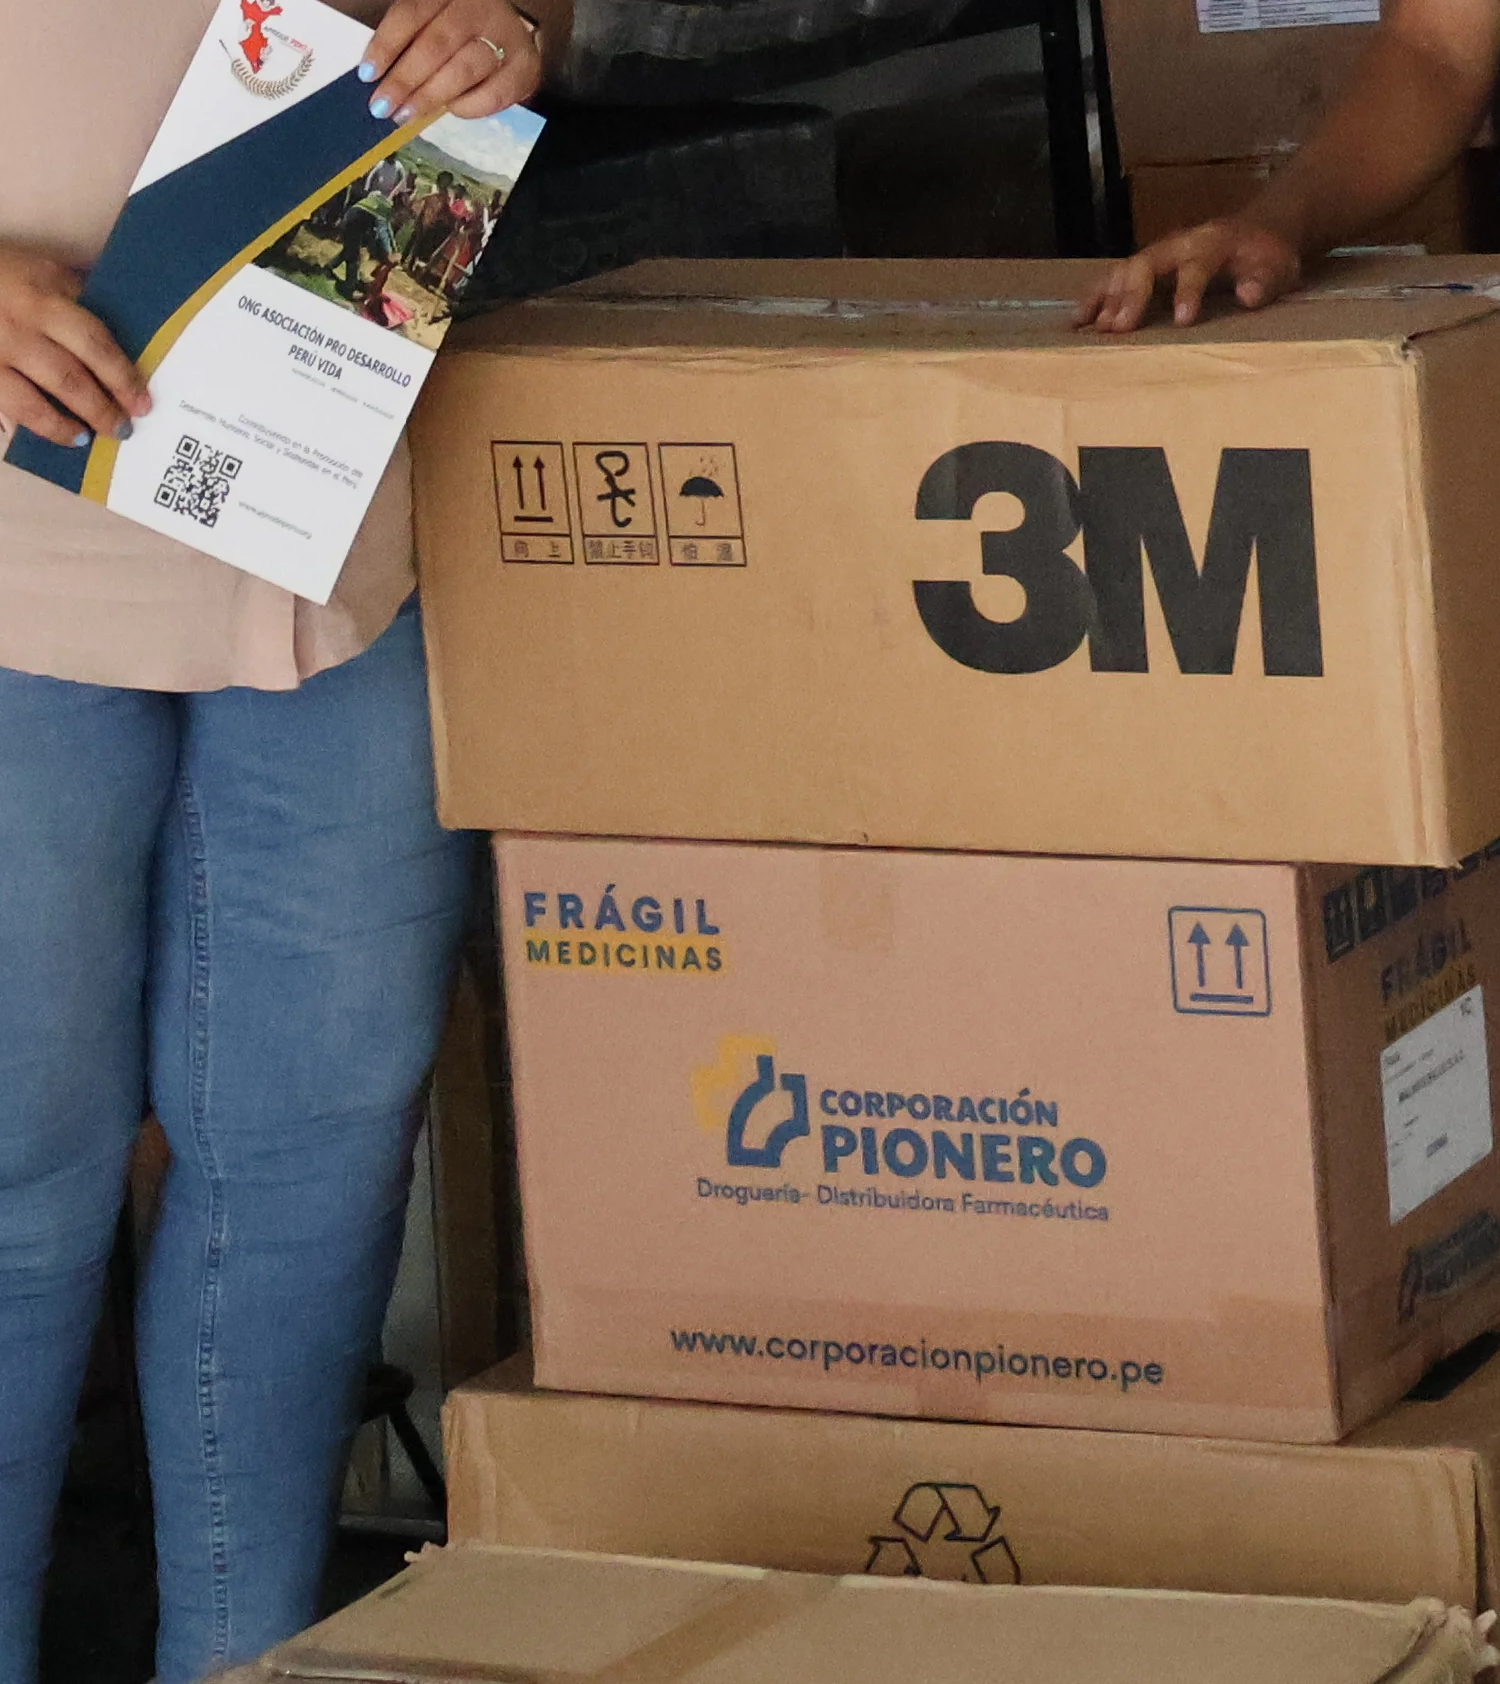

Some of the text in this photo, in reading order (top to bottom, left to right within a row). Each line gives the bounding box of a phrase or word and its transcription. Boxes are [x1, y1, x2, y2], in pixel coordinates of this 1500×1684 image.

[237, 295, 412, 388] ONG ASOCIACIÓN PRO DESARROLLO
[288, 343, 344, 380] PERÚ VIDA
[910, 441, 1325, 679] 3M
[523, 883, 720, 936] FRÁGIL
[526, 940, 724, 972] MEDICINAS
[819, 1087, 1059, 1128] CORPORACIÓN
[820, 1124, 1108, 1189] PIONERO
[817, 1184, 955, 1213] Distribuidora
[961, 1193, 1109, 1221] Farmacéutica
[670, 1328, 1164, 1393] www.corporacionpionero.pe
